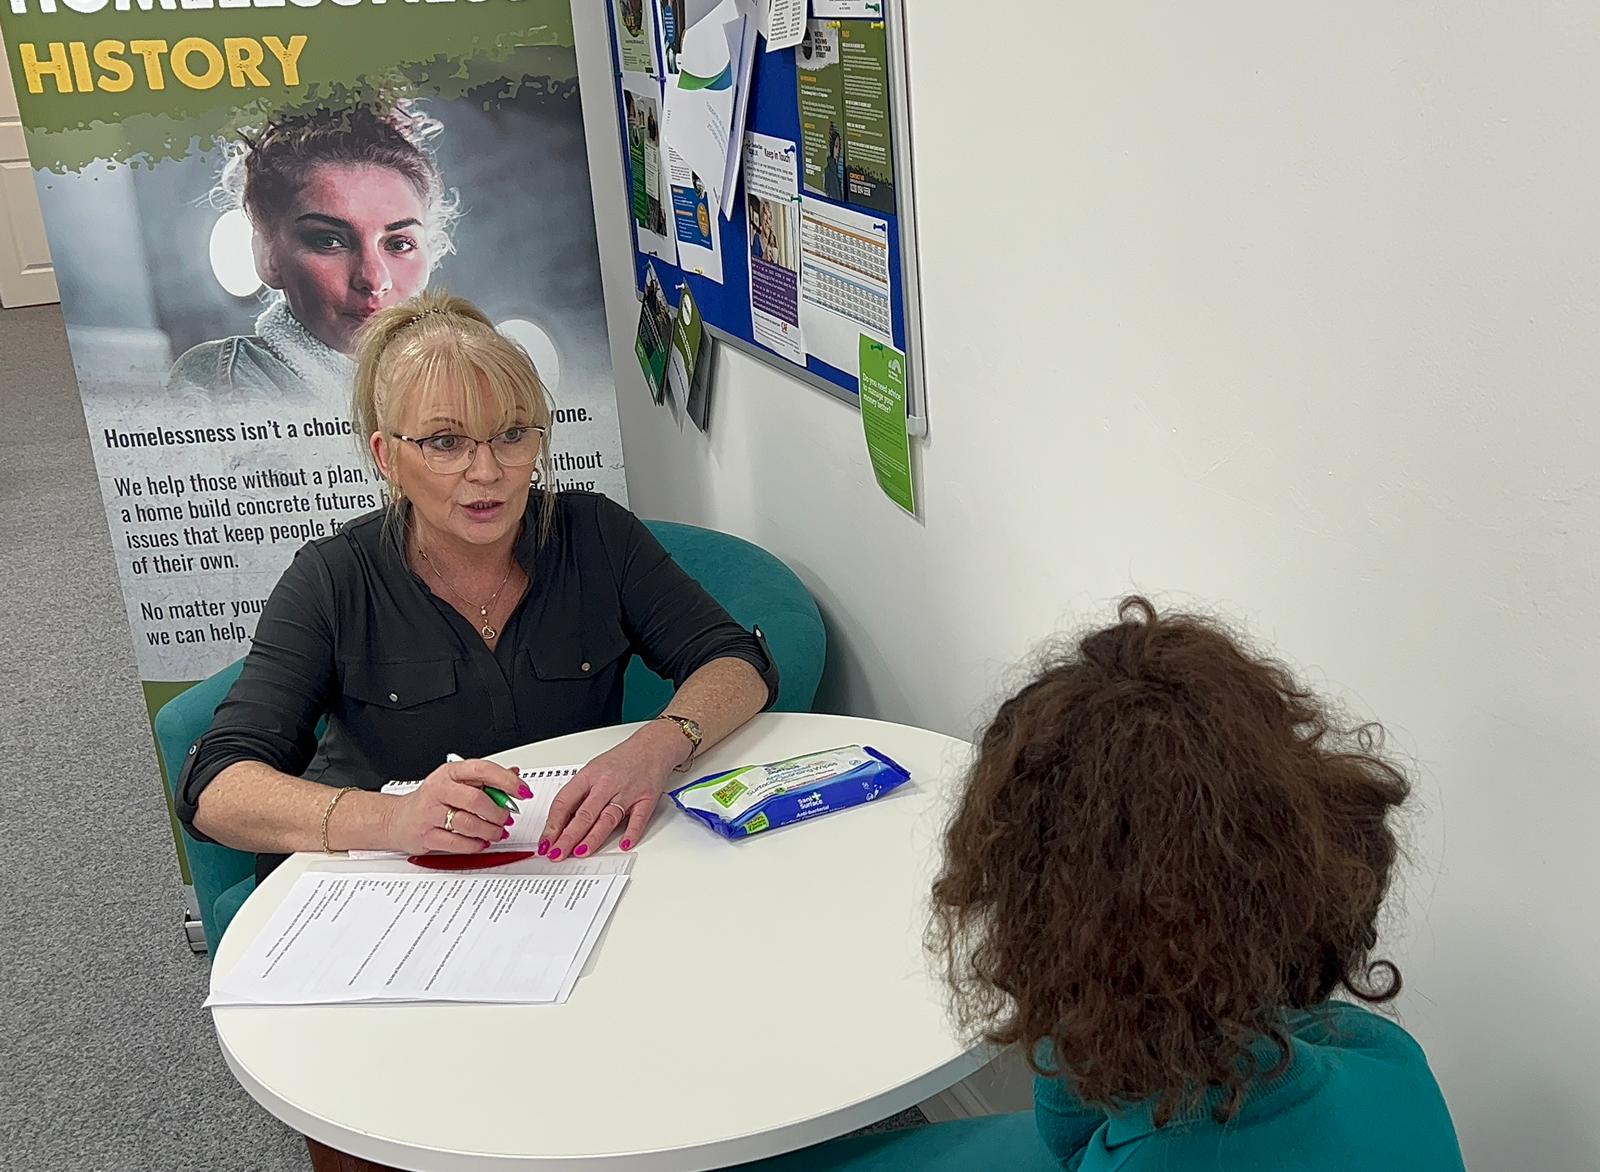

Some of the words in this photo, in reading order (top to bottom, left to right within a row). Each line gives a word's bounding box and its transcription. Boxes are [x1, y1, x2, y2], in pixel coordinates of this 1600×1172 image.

[19, 35, 308, 95] HISTORY
[104, 424, 236, 448] Homelessness
[240, 419, 282, 441] isn't
[287, 422, 298, 438] a
[114, 476, 143, 496] We
[146, 475, 185, 498] help
[190, 473, 238, 493] those
[242, 467, 308, 490] without
[312, 470, 323, 486] a
[327, 464, 369, 488] plan,
[552, 451, 604, 472] ithout
[121, 508, 132, 523] a
[134, 503, 183, 523] home
[188, 498, 232, 519] build
[236, 493, 311, 516] concrete
[315, 492, 376, 512] futures
[125, 530, 179, 549] issues
[183, 525, 220, 546] that
[224, 523, 265, 545] keep
[270, 518, 325, 542] people
[132, 556, 148, 575] of
[152, 553, 194, 574] their
[200, 553, 239, 571] own.
[141, 601, 163, 621] No
[169, 600, 226, 620] matter
[146, 629, 170, 646] we
[175, 626, 206, 643] can
[210, 621, 251, 643] help.
